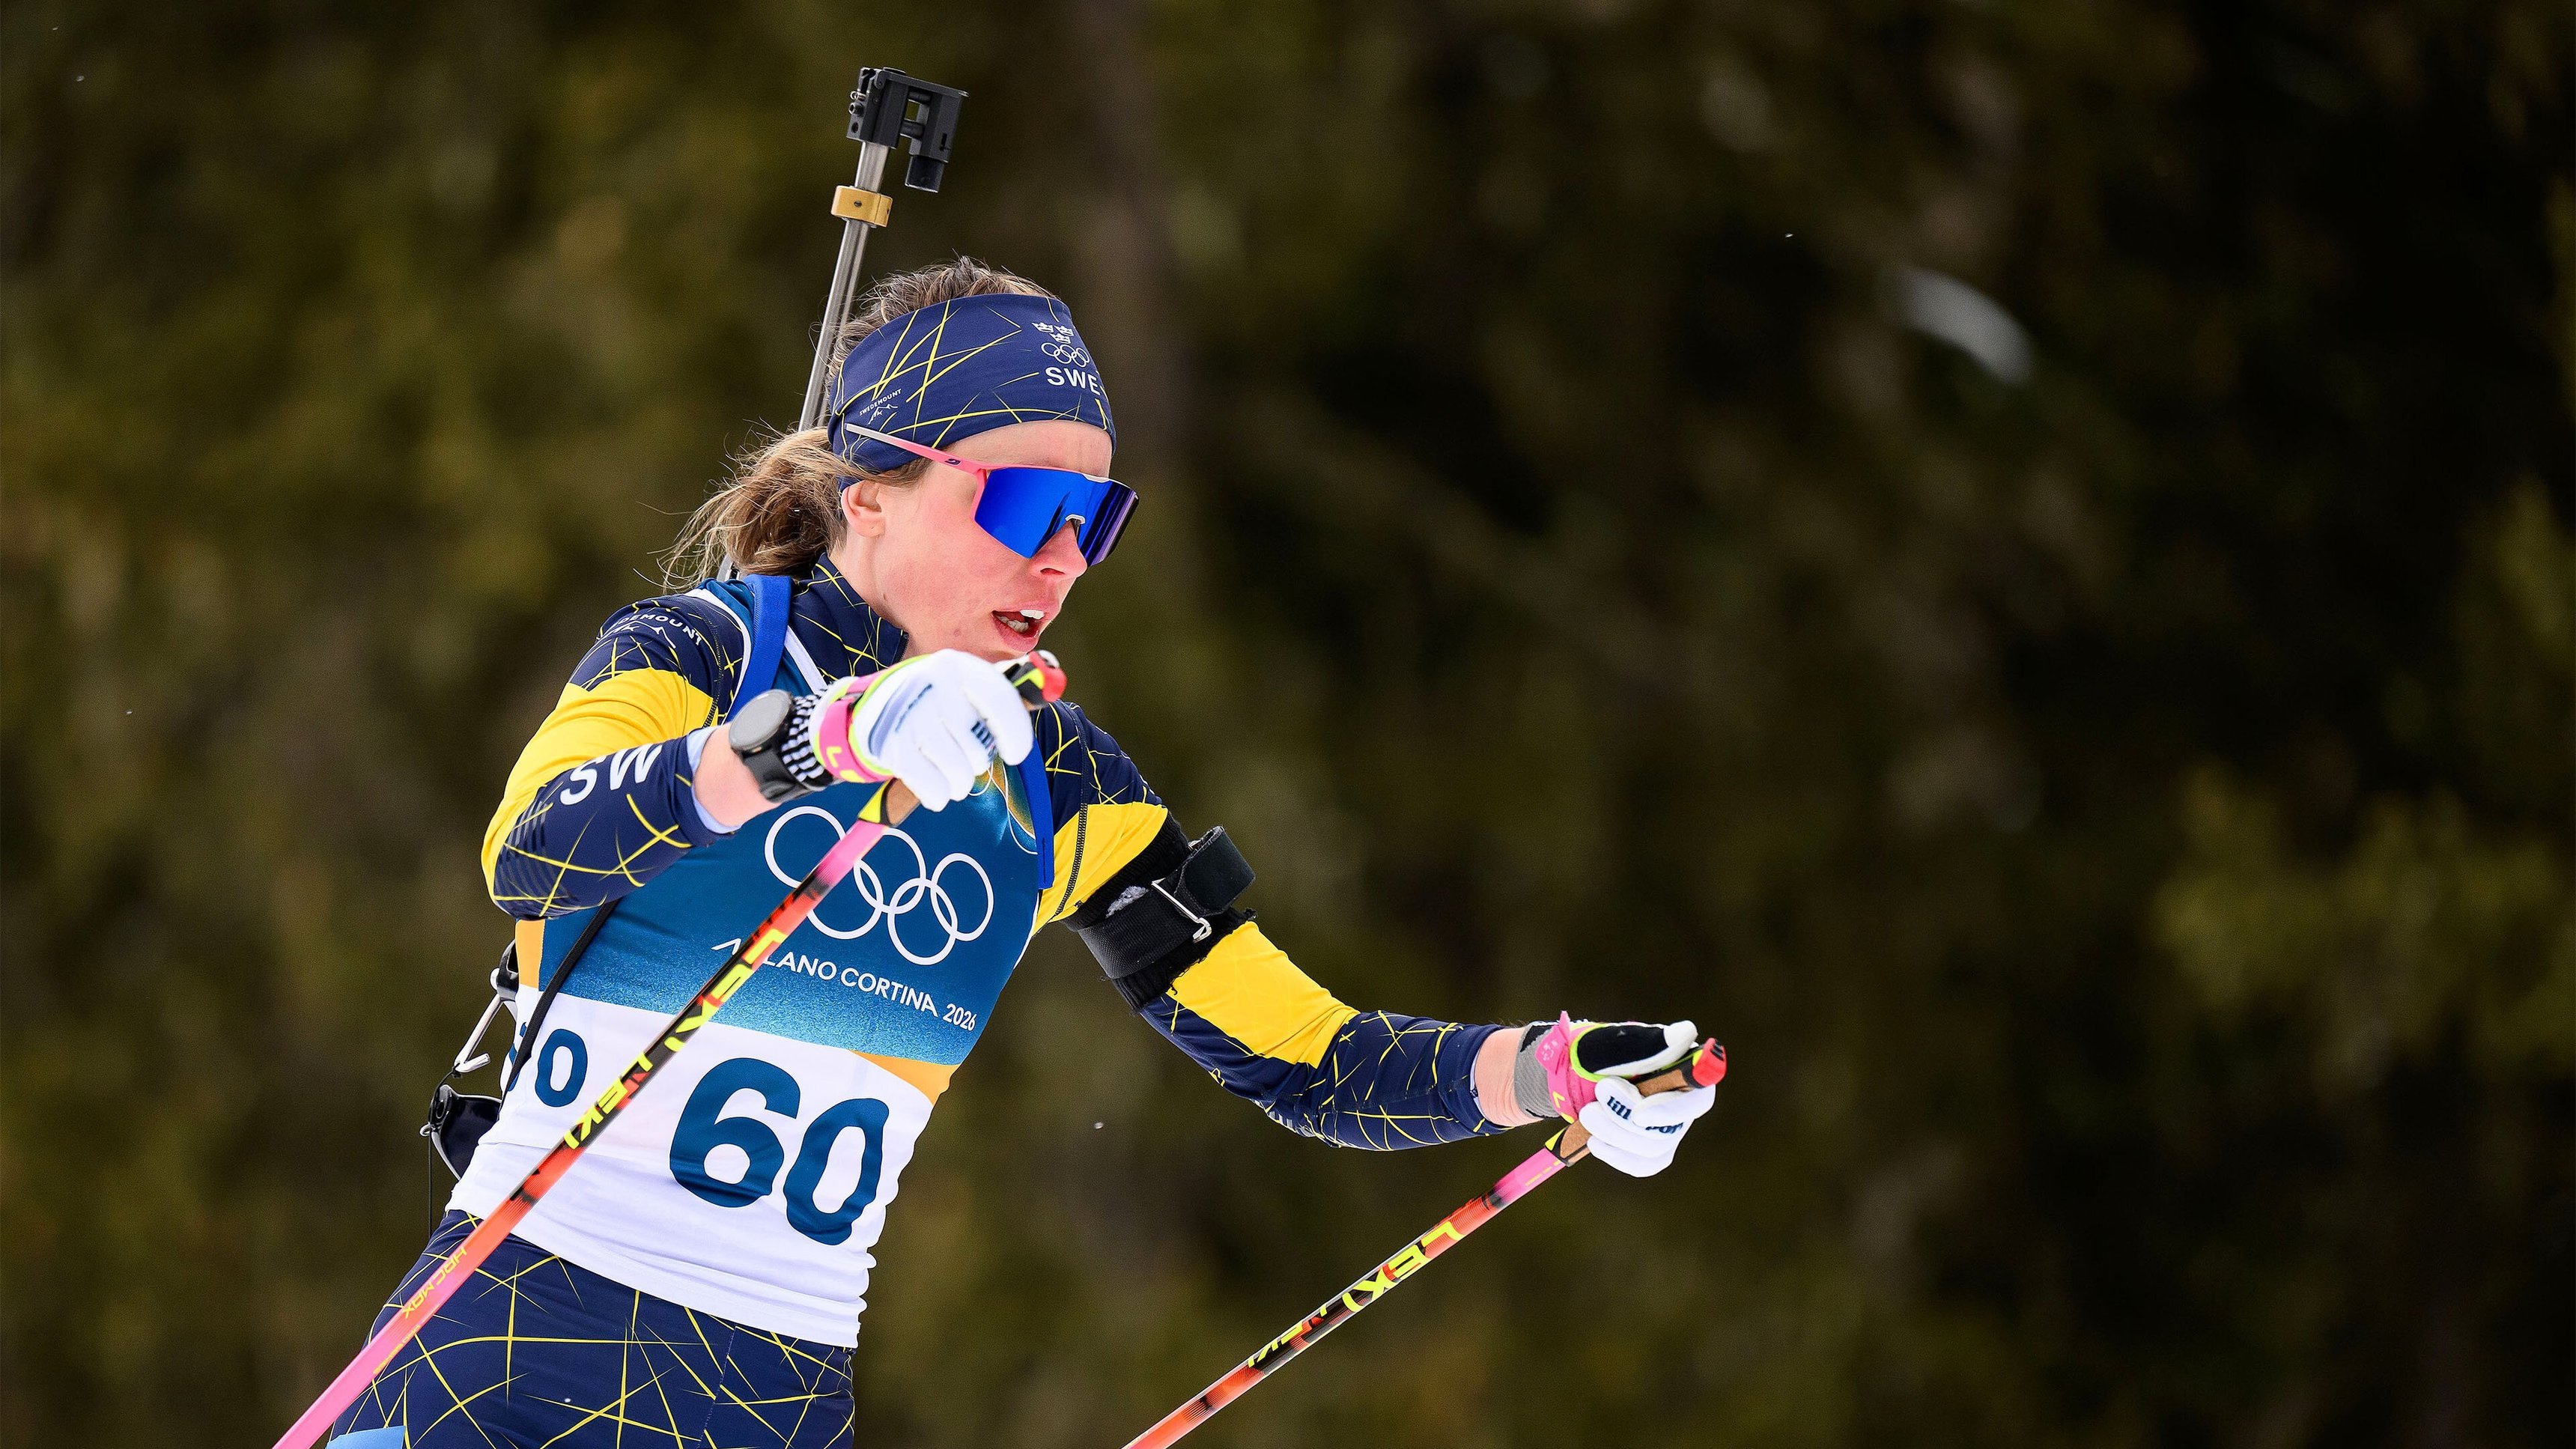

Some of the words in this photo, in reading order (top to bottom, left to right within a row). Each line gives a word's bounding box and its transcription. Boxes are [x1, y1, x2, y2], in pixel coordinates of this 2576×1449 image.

[859, 389, 902, 416] SWEDEMOUNT
[1045, 366, 1102, 396] SWE
[839, 967, 939, 1018] CORTINA
[942, 1003, 976, 1032] 2026
[563, 1051, 654, 1149] LEKI
[669, 1057, 890, 1246] 60
[1341, 1220, 1466, 1312] LEKI
[401, 1283, 435, 1319] MAX
